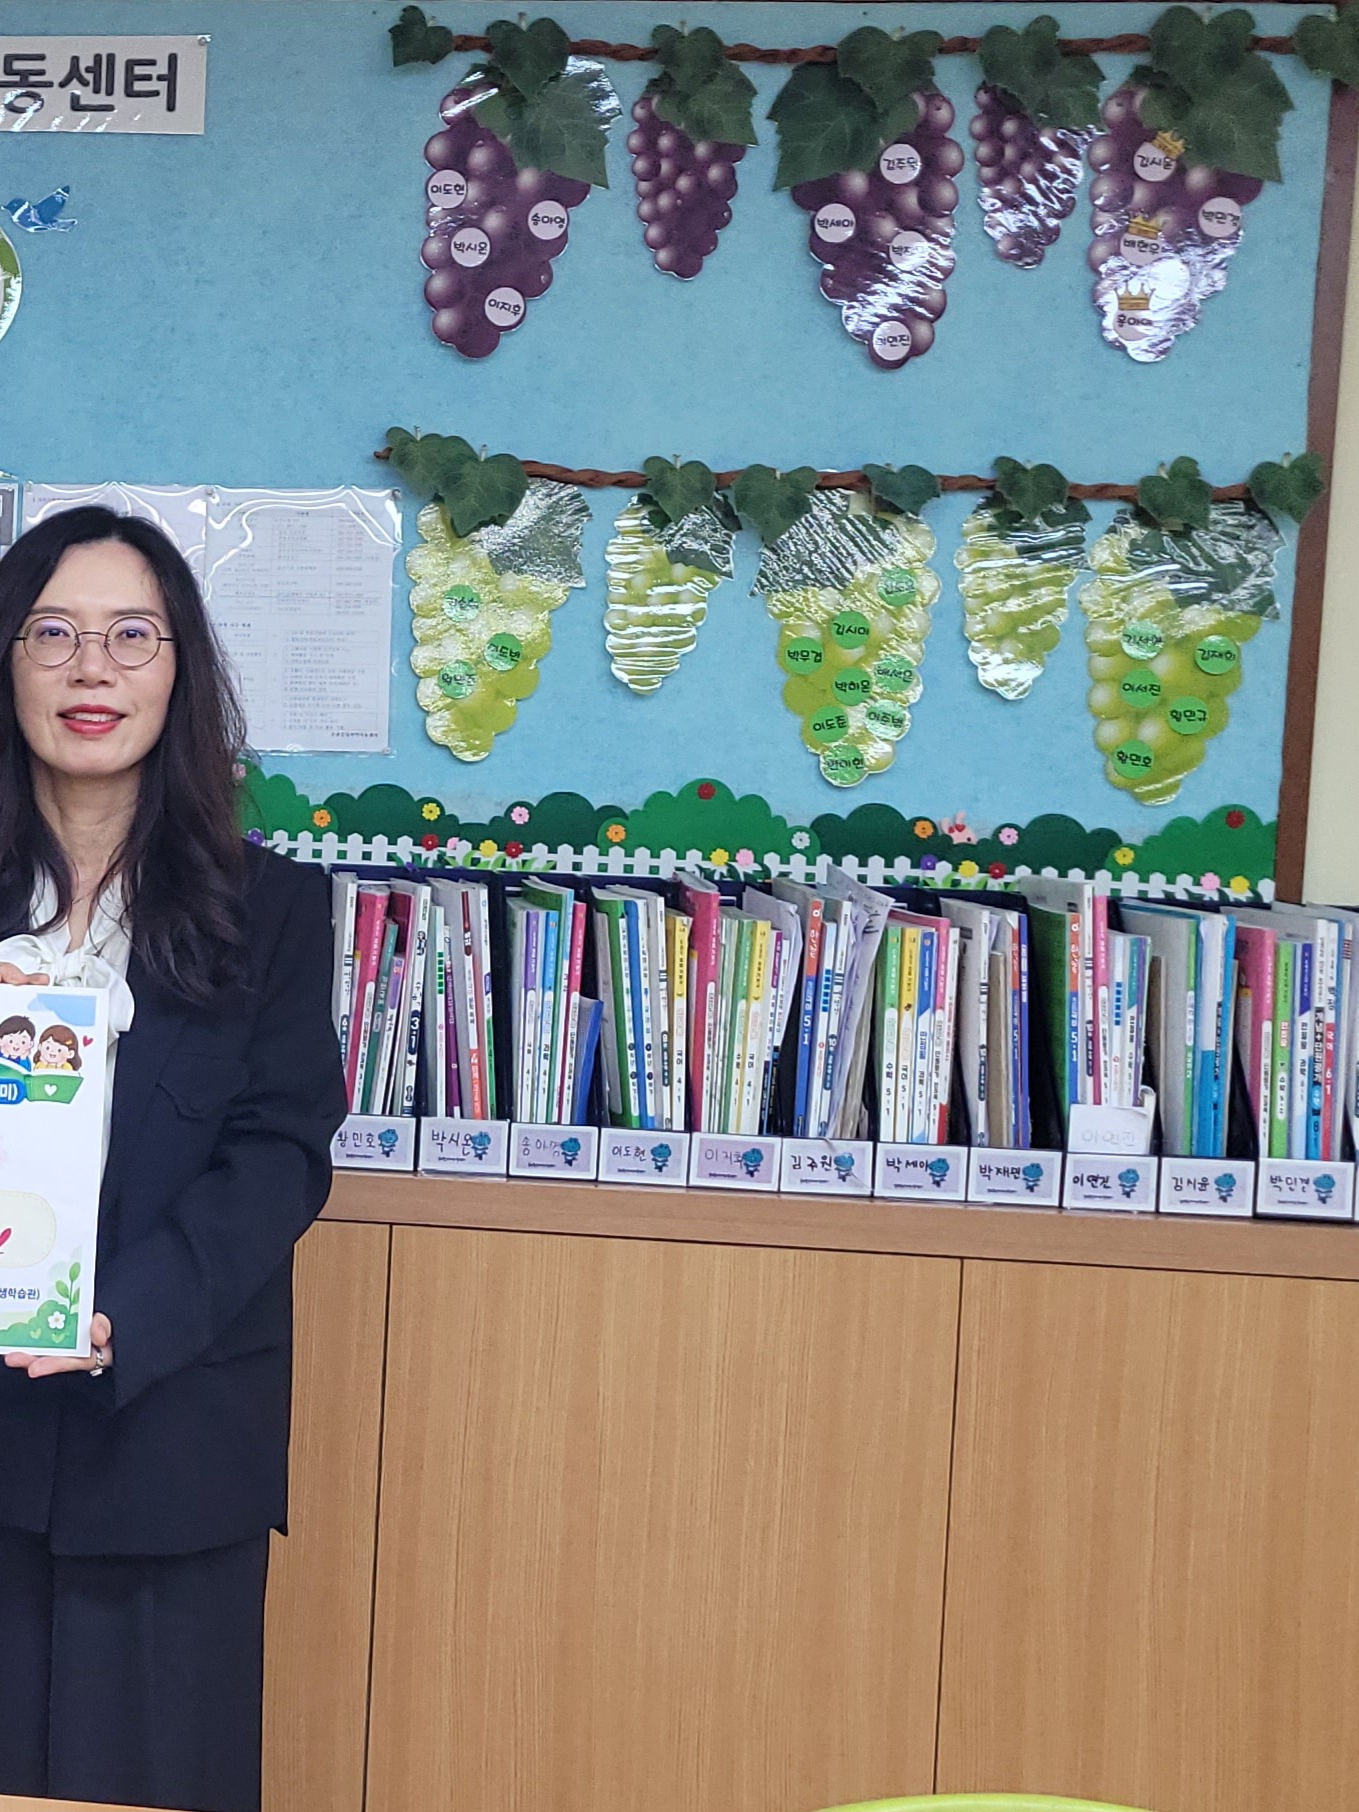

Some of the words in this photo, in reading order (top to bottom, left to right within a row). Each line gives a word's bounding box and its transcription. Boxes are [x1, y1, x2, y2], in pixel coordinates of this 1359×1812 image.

[430, 182, 466, 196] 이도현
[530, 211, 566, 229] 송아영
[817, 216, 854, 230] 박세아
[1122, 681, 1162, 697] 이서진
[431, 1128, 472, 1156] 박시온
[612, 1145, 647, 1161] 이도현
[791, 1155, 833, 1171] 김주원
[886, 1158, 930, 1173] 박세아
[1072, 1173, 1112, 1189] 이연진
[1171, 1176, 1210, 1192] 김시윤
